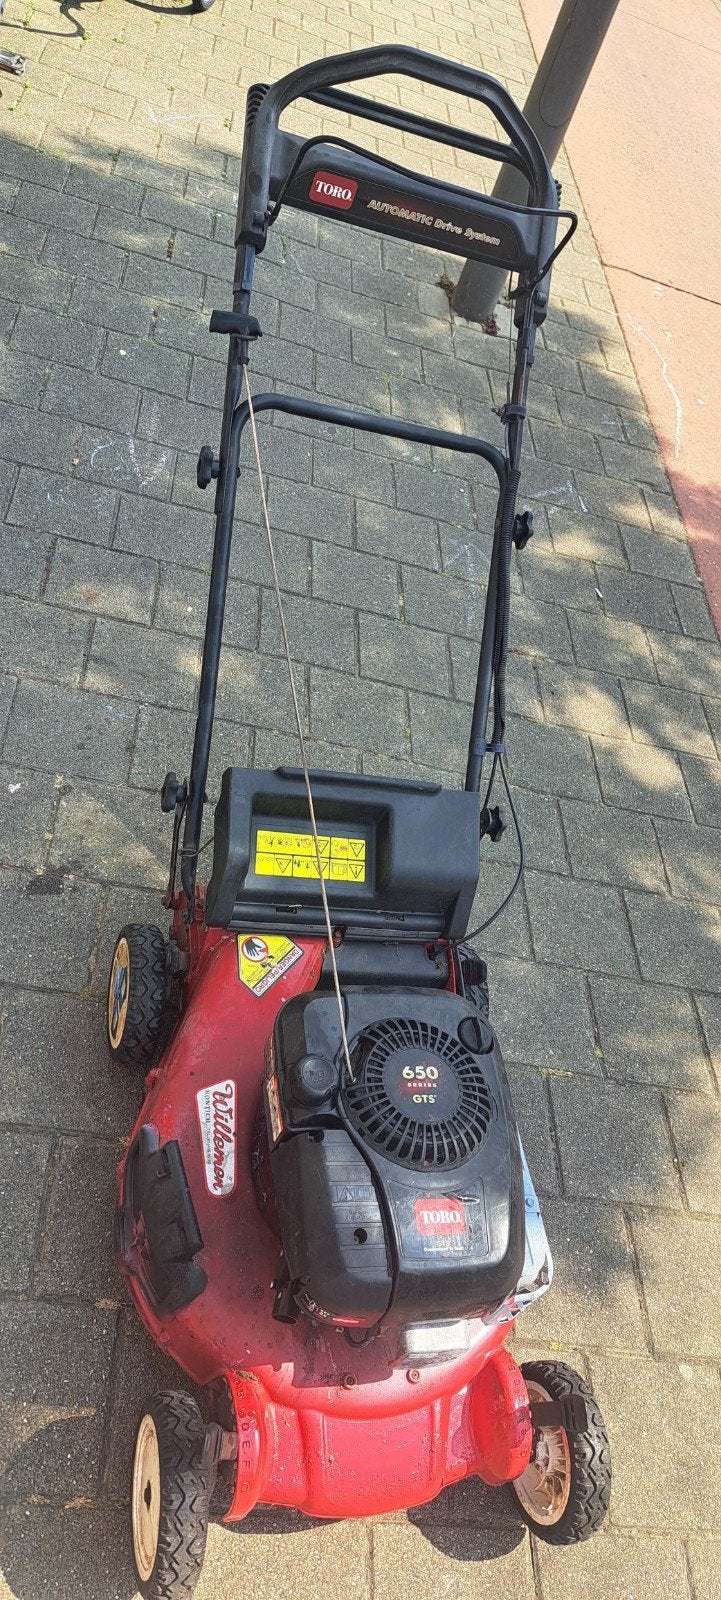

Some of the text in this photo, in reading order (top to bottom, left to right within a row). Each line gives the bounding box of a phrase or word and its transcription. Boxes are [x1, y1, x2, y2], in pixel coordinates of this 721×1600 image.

[315, 180, 351, 201] TORO
[367, 200, 501, 247] AUTOMATIC Drive System
[402, 1065, 439, 1080] 650
[212, 1084, 234, 1191] Willemen
[420, 1210, 461, 1224] TORO
[242, 1440, 250, 1449] E
[242, 1459, 251, 1468] F
